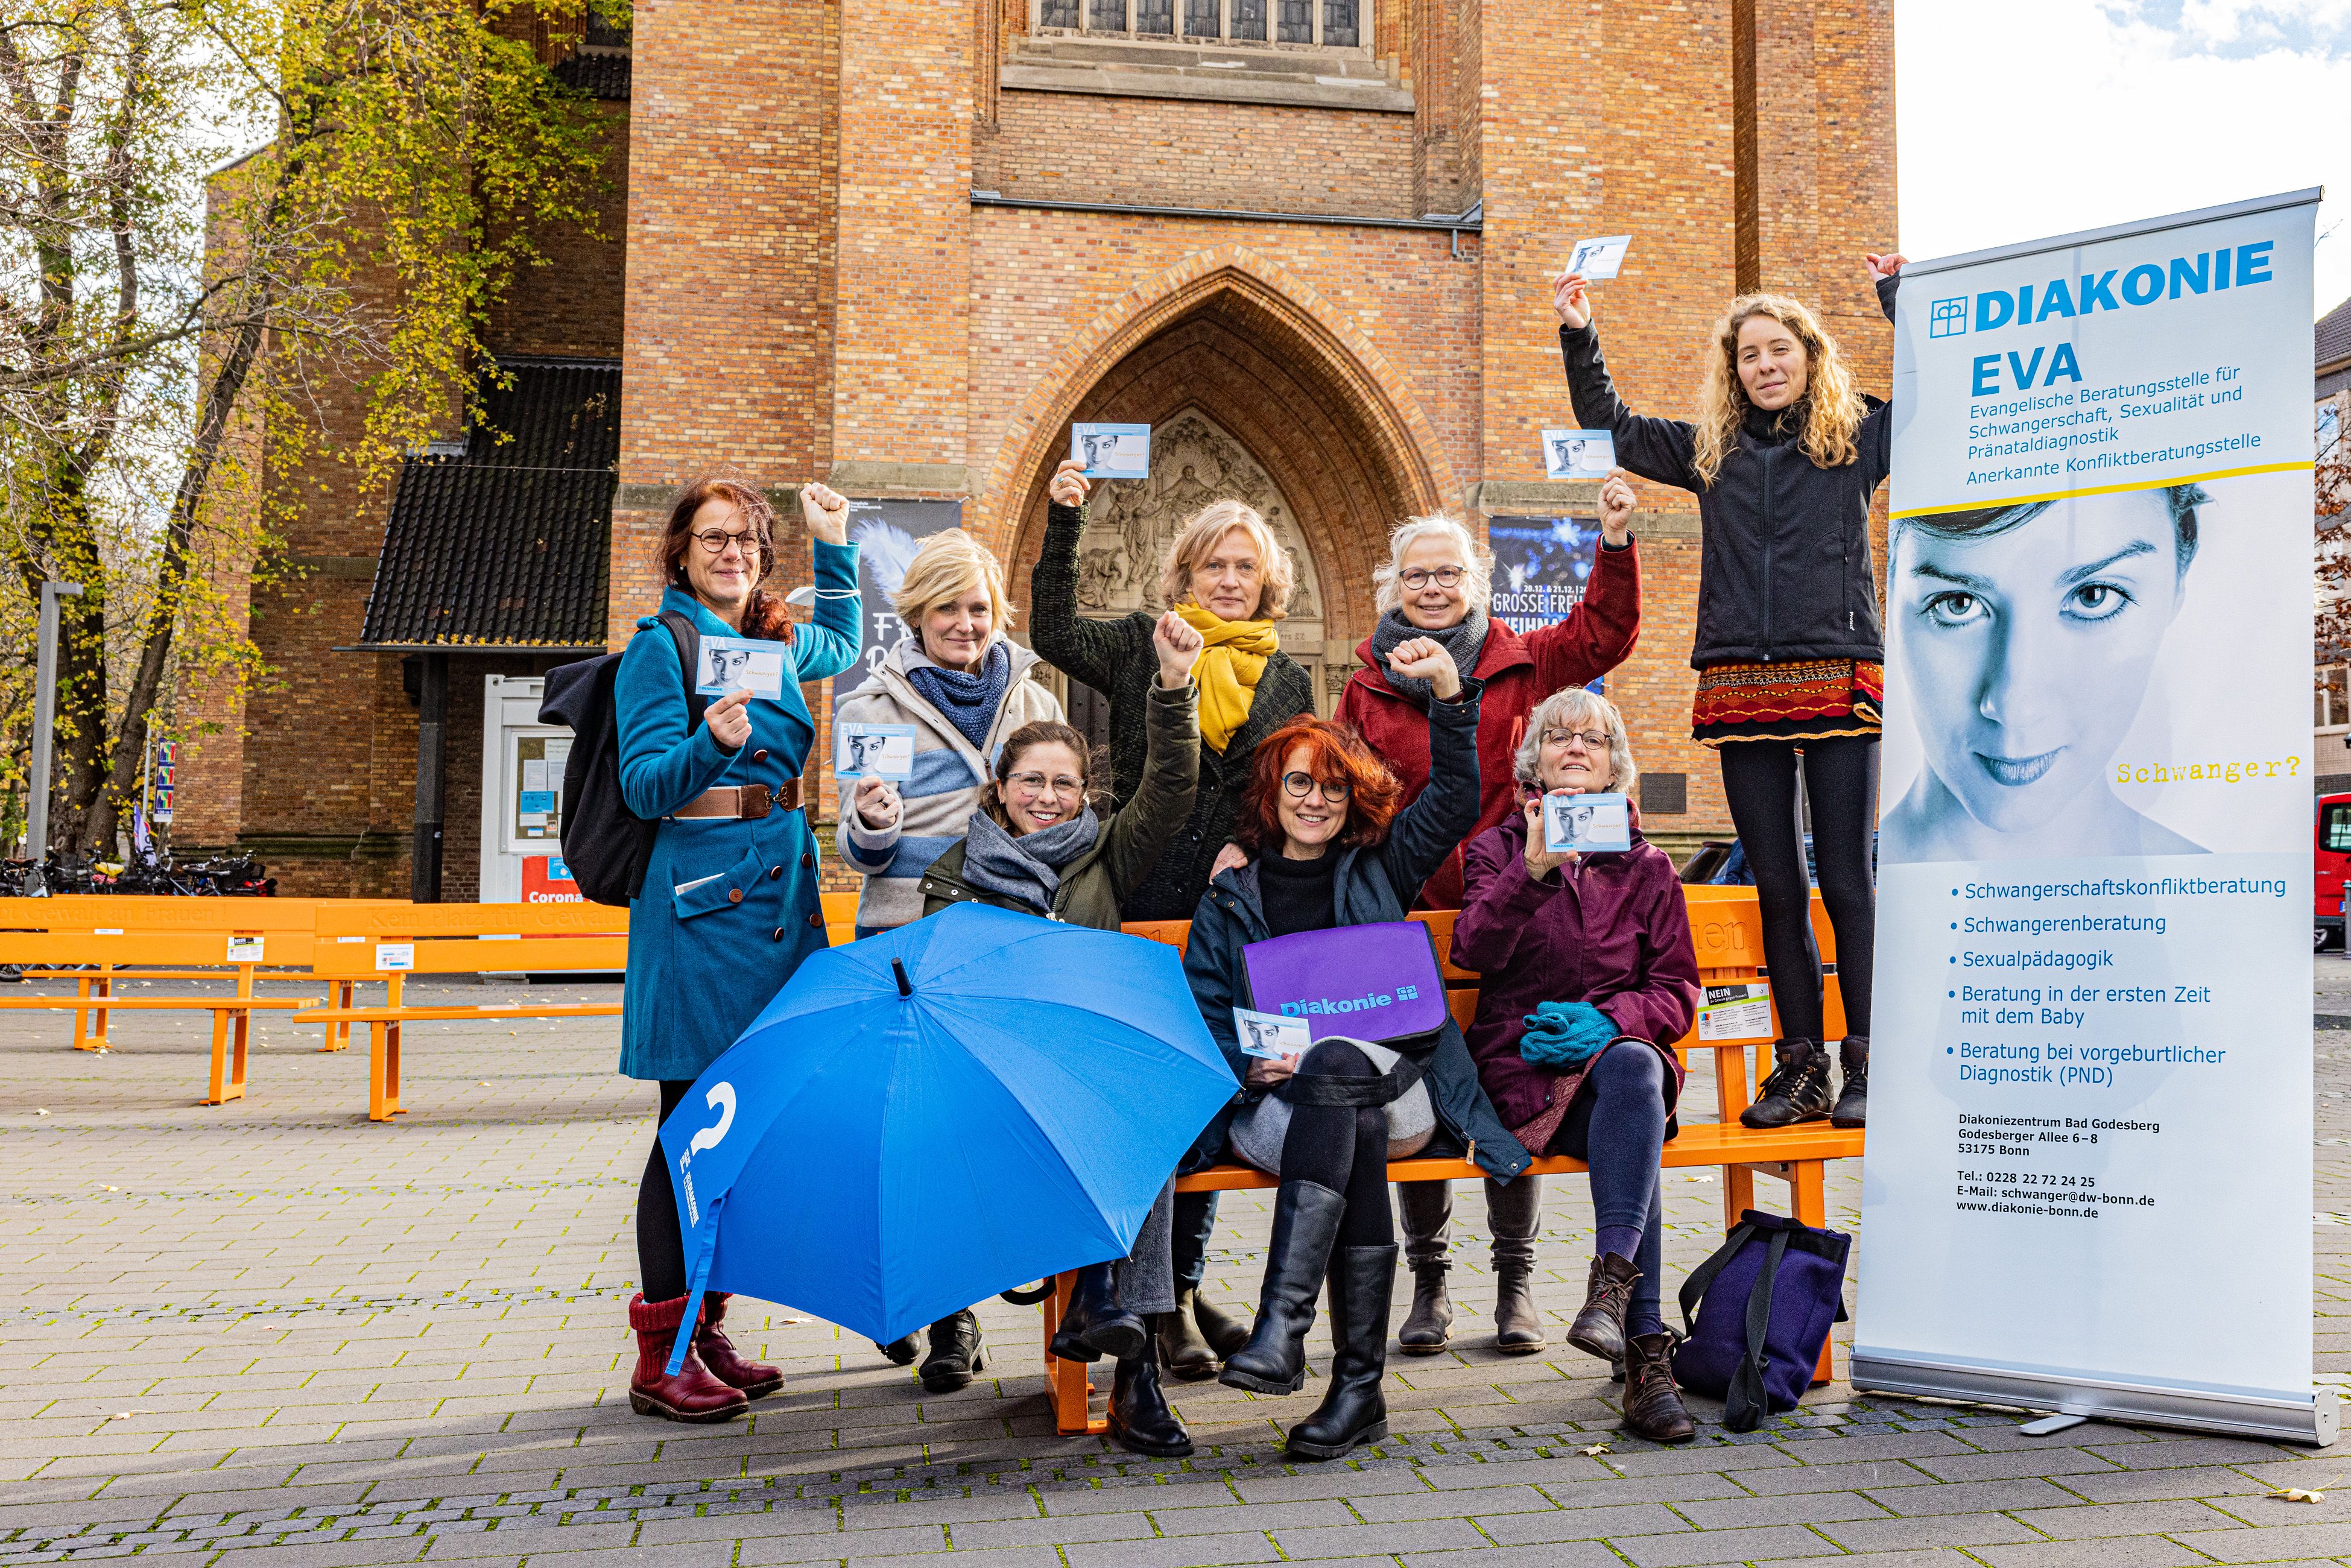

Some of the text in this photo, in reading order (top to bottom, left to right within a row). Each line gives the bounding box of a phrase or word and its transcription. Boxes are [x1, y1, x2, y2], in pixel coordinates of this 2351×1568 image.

[1975, 239, 2274, 332] DIAKONIE
[1972, 342, 2083, 397] EVA
[1970, 366, 2241, 419] Evangelische Beratungsstelle für
[1969, 385, 2242, 439] Schwangerschaft, Sexualität und
[1075, 424, 1096, 435] EVA
[1969, 426, 2119, 460] Pränataldiagnostik
[1966, 432, 2261, 485] Anerkannte Konfliktberatungsstelle
[1493, 593, 1545, 613] GROSSE
[702, 635, 726, 650] EVA
[841, 723, 864, 736] EVA
[2117, 756, 2301, 783] Schwanger?
[1547, 795, 1571, 807] EVA
[528, 893, 583, 903] Corona
[1965, 877, 2286, 902] Schwangerschaftskonfliktberatung
[25, 902, 102, 922] Gewalt
[109, 908, 134, 922] an
[144, 903, 214, 922] Frauen
[366, 907, 420, 929] Kein
[429, 906, 484, 928] Platz
[491, 906, 529, 928] für
[535, 905, 618, 926] Gewalt
[1963, 914, 2166, 936] Schwangerenberatung
[1963, 949, 2113, 970] Sexualpädagogik
[1708, 988, 1731, 999] NEIN
[1963, 985, 2211, 1006] Beratung in der ersten Zeit
[1235, 1008, 1257, 1021] EVA
[1280, 993, 1392, 1018] Diakonie
[1962, 1007, 2085, 1029] mit dem Baby
[1961, 1042, 2226, 1065] Beratung bei vorgeburtlicher
[1960, 1064, 2113, 1088] Diagnostik (PND)
[1959, 1113, 2160, 1134] Diakoniezentrum Bad Godesberg
[1958, 1128, 2035, 1143] Godesberger
[2038, 1131, 2069, 1143] Allee
[1958, 1143, 2030, 1156] 53175 Bonn
[1957, 1170, 2095, 1187] Tel.: 0228 22 72 24 25
[1957, 1185, 2155, 1206] E-Mail: schwanger@dw-bonn.de
[1956, 1201, 2098, 1218] www.diakonie-bonn.de
